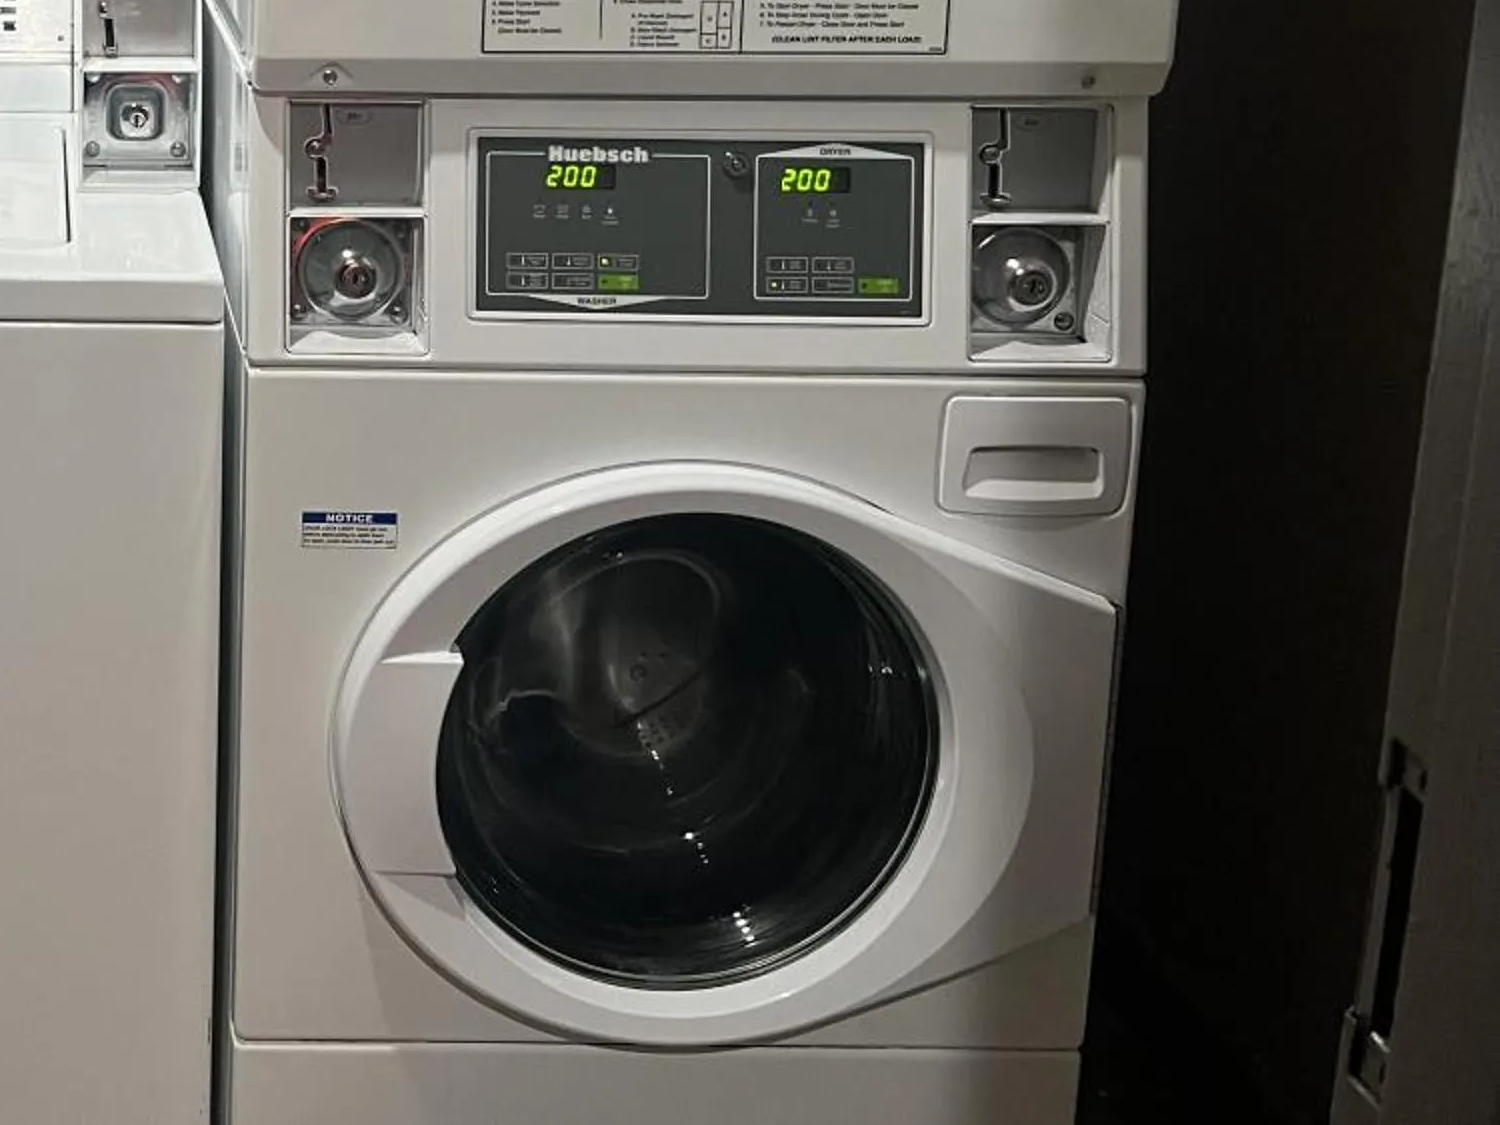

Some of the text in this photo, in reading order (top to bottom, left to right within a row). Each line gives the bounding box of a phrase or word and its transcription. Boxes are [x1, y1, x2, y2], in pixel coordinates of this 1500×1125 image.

[547, 145, 649, 163] Huebsch
[820, 147, 851, 156] DRYER
[546, 166, 597, 188] 200
[781, 169, 832, 192] 200
[577, 297, 617, 305] WASHER
[325, 513, 373, 523] NOTICE
